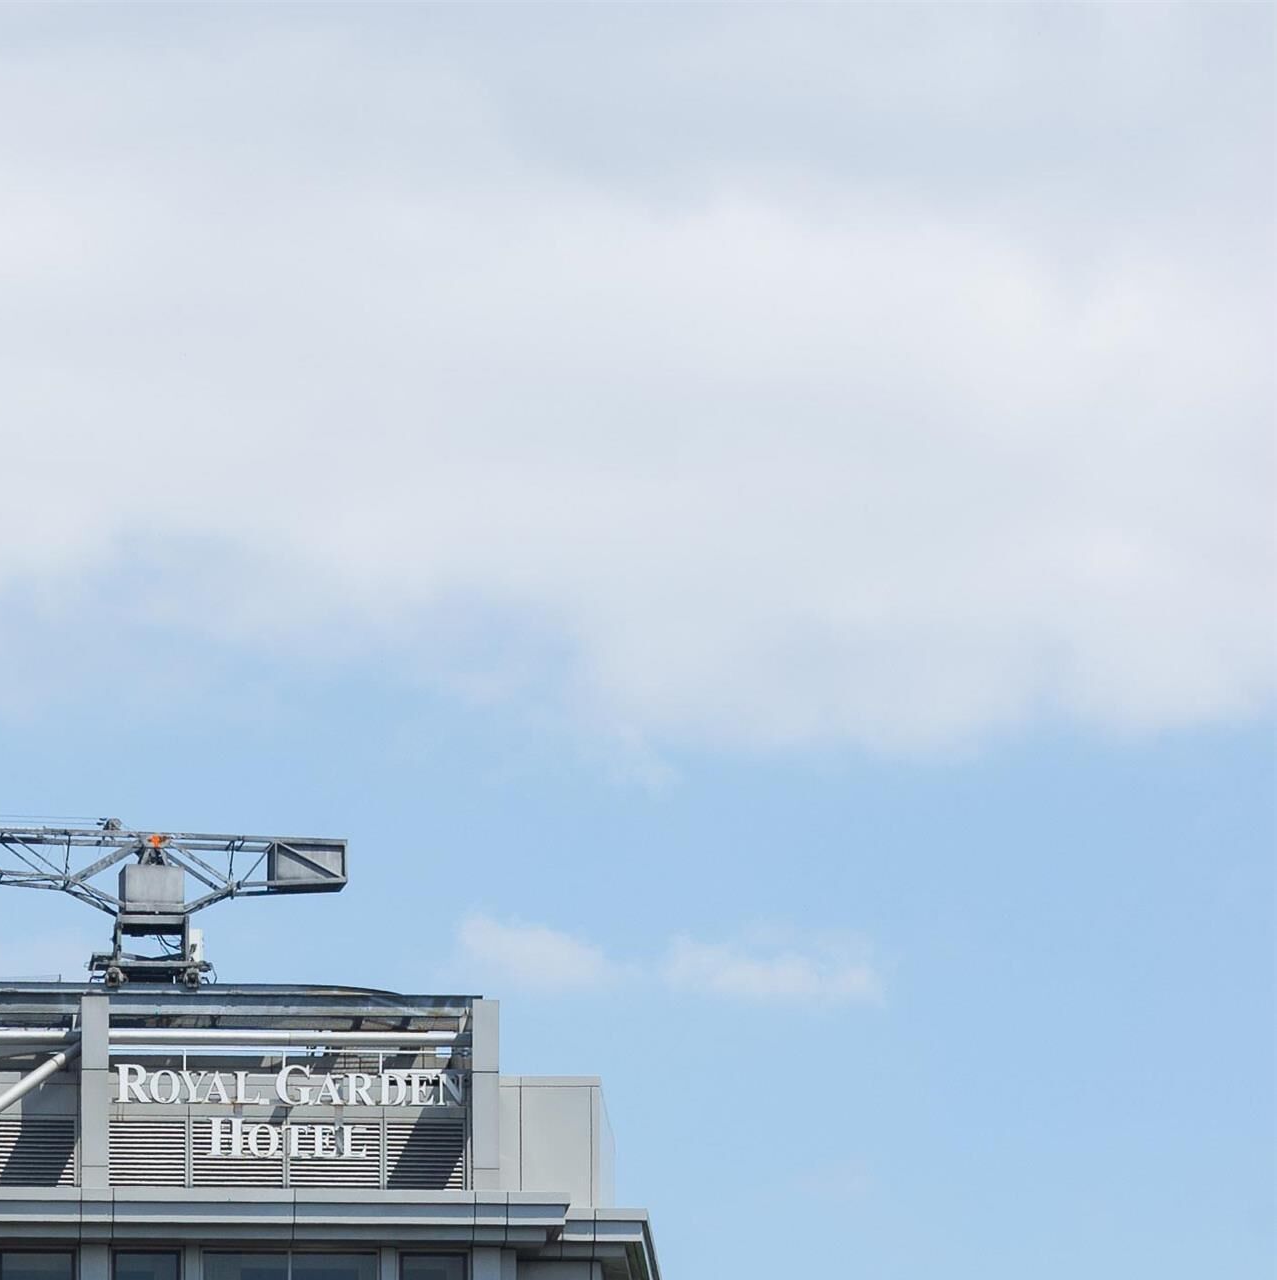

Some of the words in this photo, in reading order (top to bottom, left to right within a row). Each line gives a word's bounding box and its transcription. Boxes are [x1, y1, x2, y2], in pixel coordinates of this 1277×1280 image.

[113, 1063, 270, 1105] ROYAL
[275, 1064, 465, 1107] GARDEN
[208, 1118, 367, 1158] HOTEL
